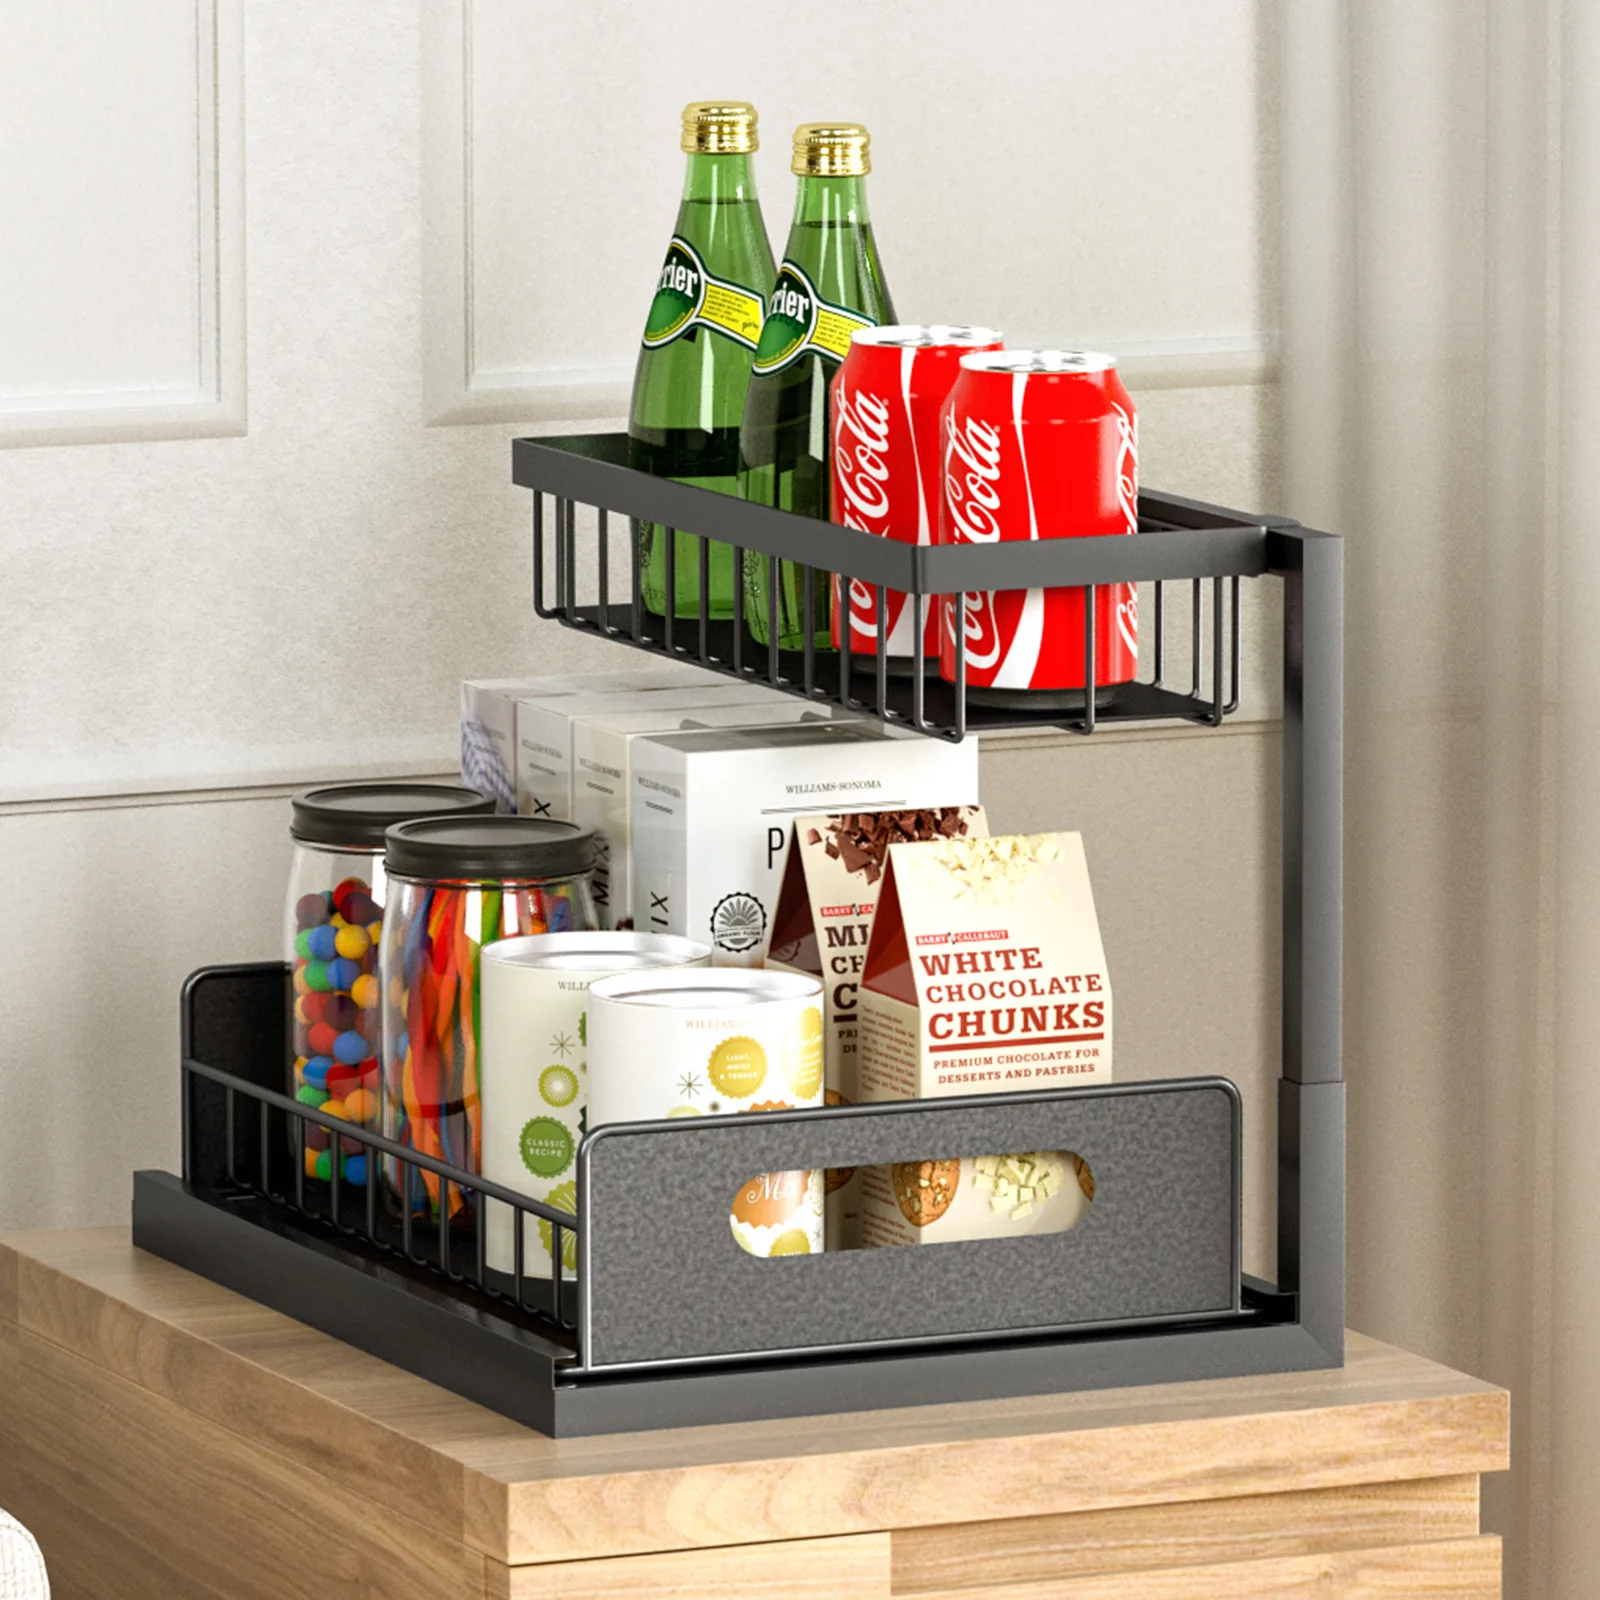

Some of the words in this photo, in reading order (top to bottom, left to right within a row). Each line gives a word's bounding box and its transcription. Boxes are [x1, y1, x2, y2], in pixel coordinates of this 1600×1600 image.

[650, 890, 669, 934] IX
[824, 924, 869, 948] MI
[917, 934, 947, 945] BARRY
[957, 931, 1007, 942] CALLEBAUT
[919, 947, 1043, 976] WHITE
[926, 974, 1103, 1004] CHOCOLATE
[928, 1001, 1105, 1040] CHUNKS
[933, 1056, 993, 1070] PREMIUM
[997, 1050, 1072, 1065] CHOCOLATE
[1075, 1048, 1100, 1058] FOR
[938, 1070, 1001, 1085] DESSERTS
[1005, 1068, 1032, 1079] AND
[1035, 1063, 1096, 1077] PASTRIES
[526, 1137, 567, 1149] CLASSIC
[529, 1147, 563, 1158] RECIPE
